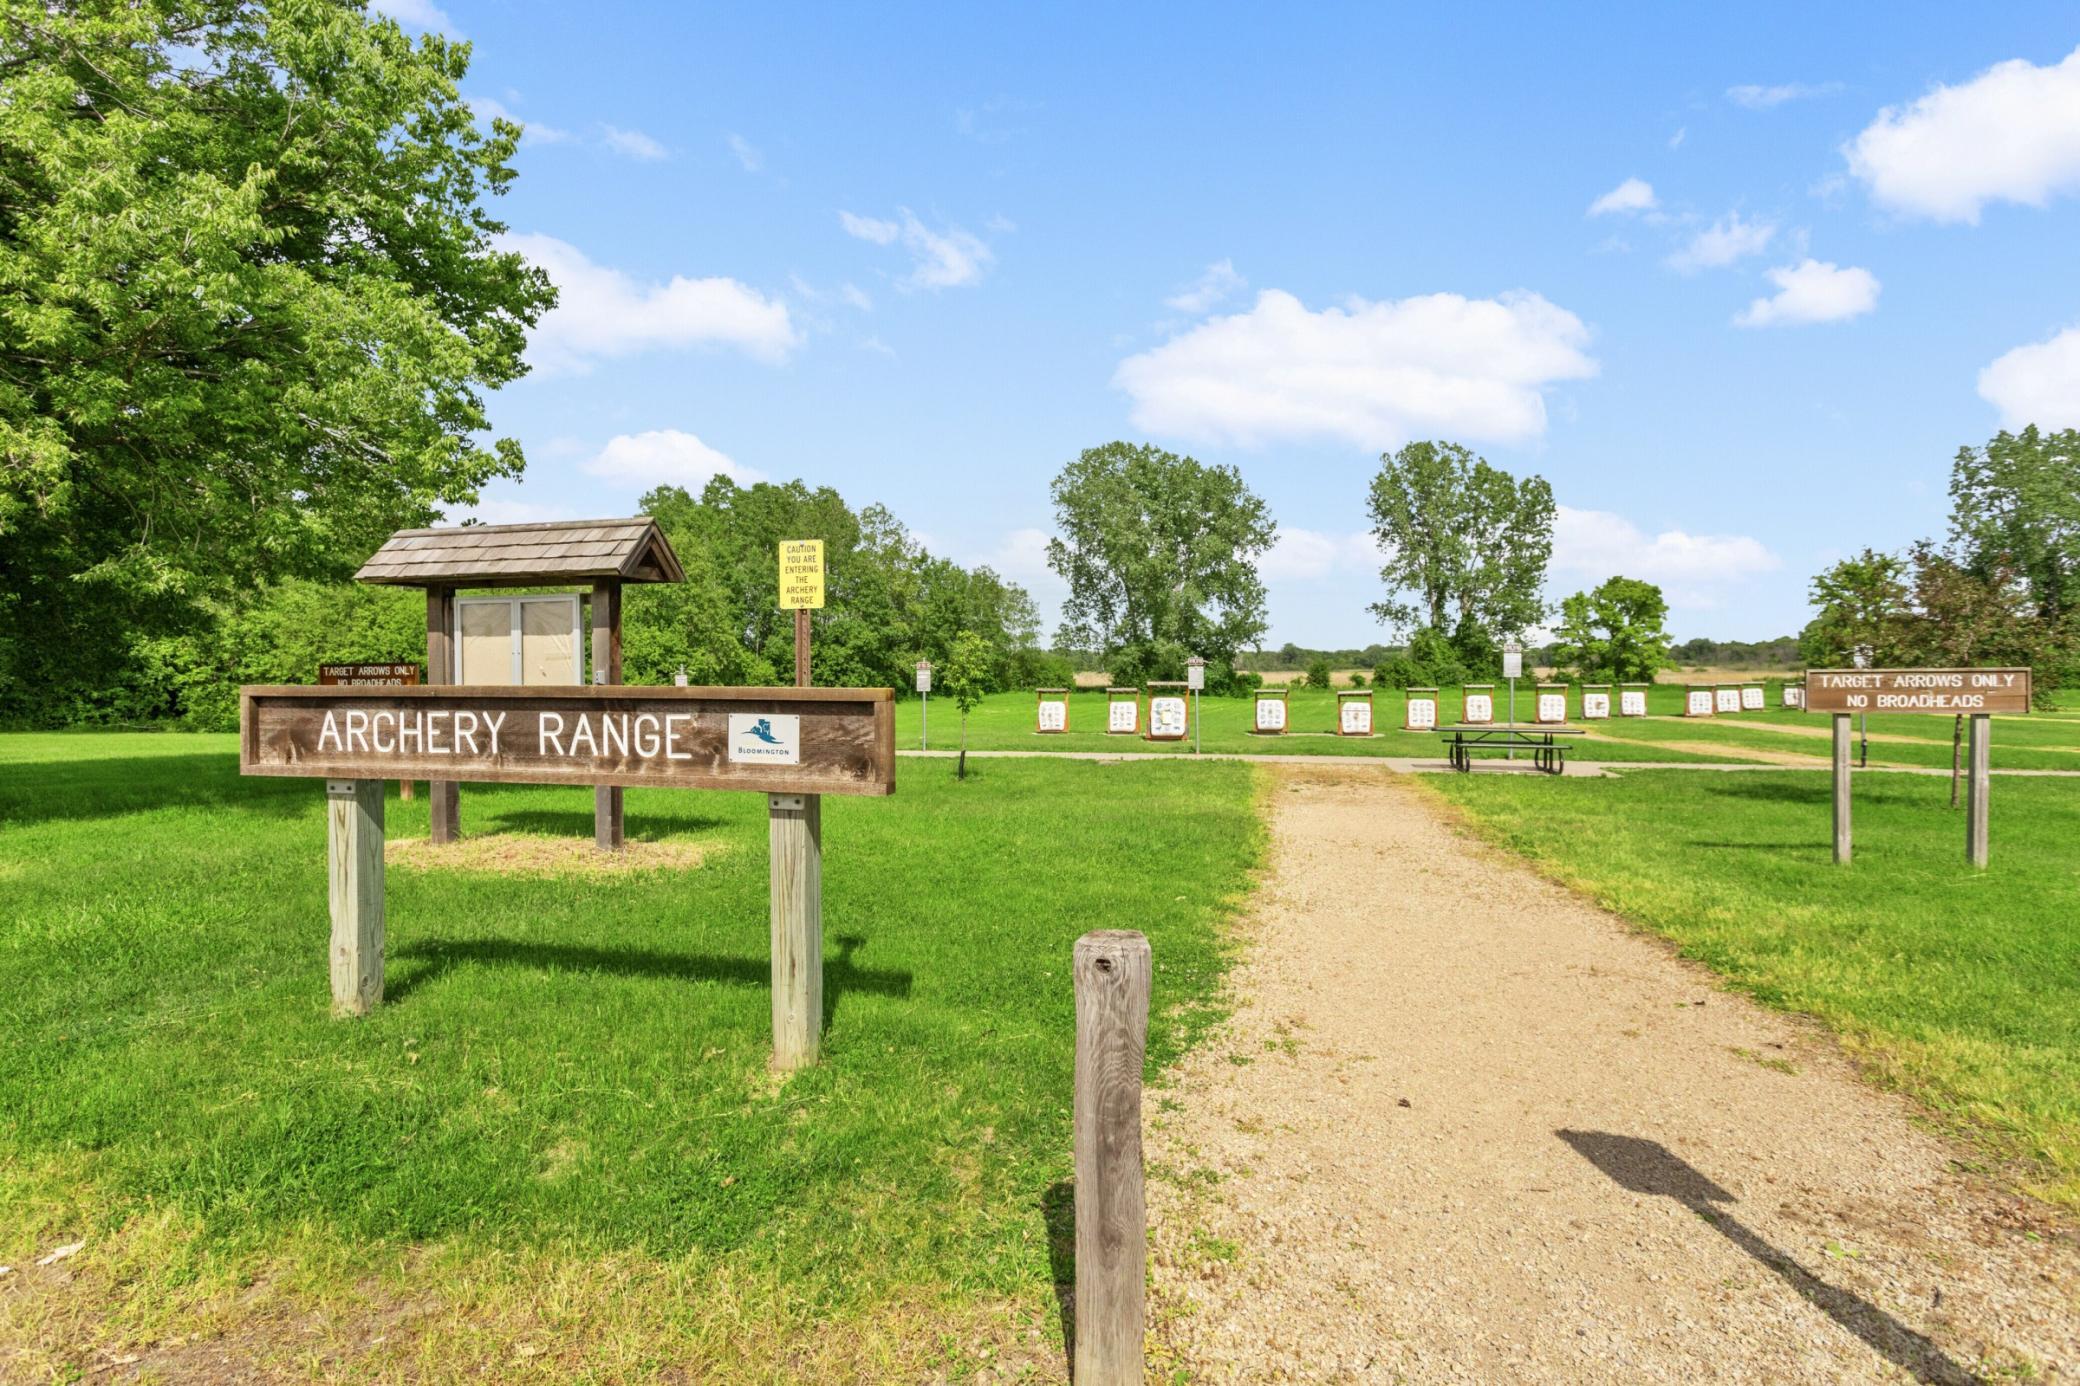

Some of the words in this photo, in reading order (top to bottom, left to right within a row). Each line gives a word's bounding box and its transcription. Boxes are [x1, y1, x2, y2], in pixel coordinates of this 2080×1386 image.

[787, 545, 816, 553] CAUTION
[804, 555, 816, 563] ARE
[785, 565, 818, 574] ENTERING
[786, 586, 817, 594] ARCHERY
[791, 596, 814, 604] RANGE
[323, 667, 354, 676] TARGET
[358, 666, 390, 676] ARROWS
[394, 665, 415, 676] ONLY
[1820, 675, 1884, 688] TARGET
[1893, 674, 1963, 688] ARROWS
[1971, 674, 2015, 687] ONLY
[1846, 694, 1868, 708] NO
[1877, 694, 1984, 708] BROADHEADS
[317, 710, 506, 754] ARCHERY
[539, 712, 692, 759] RANGE
[738, 746, 789, 755] BLOOMINGTON
